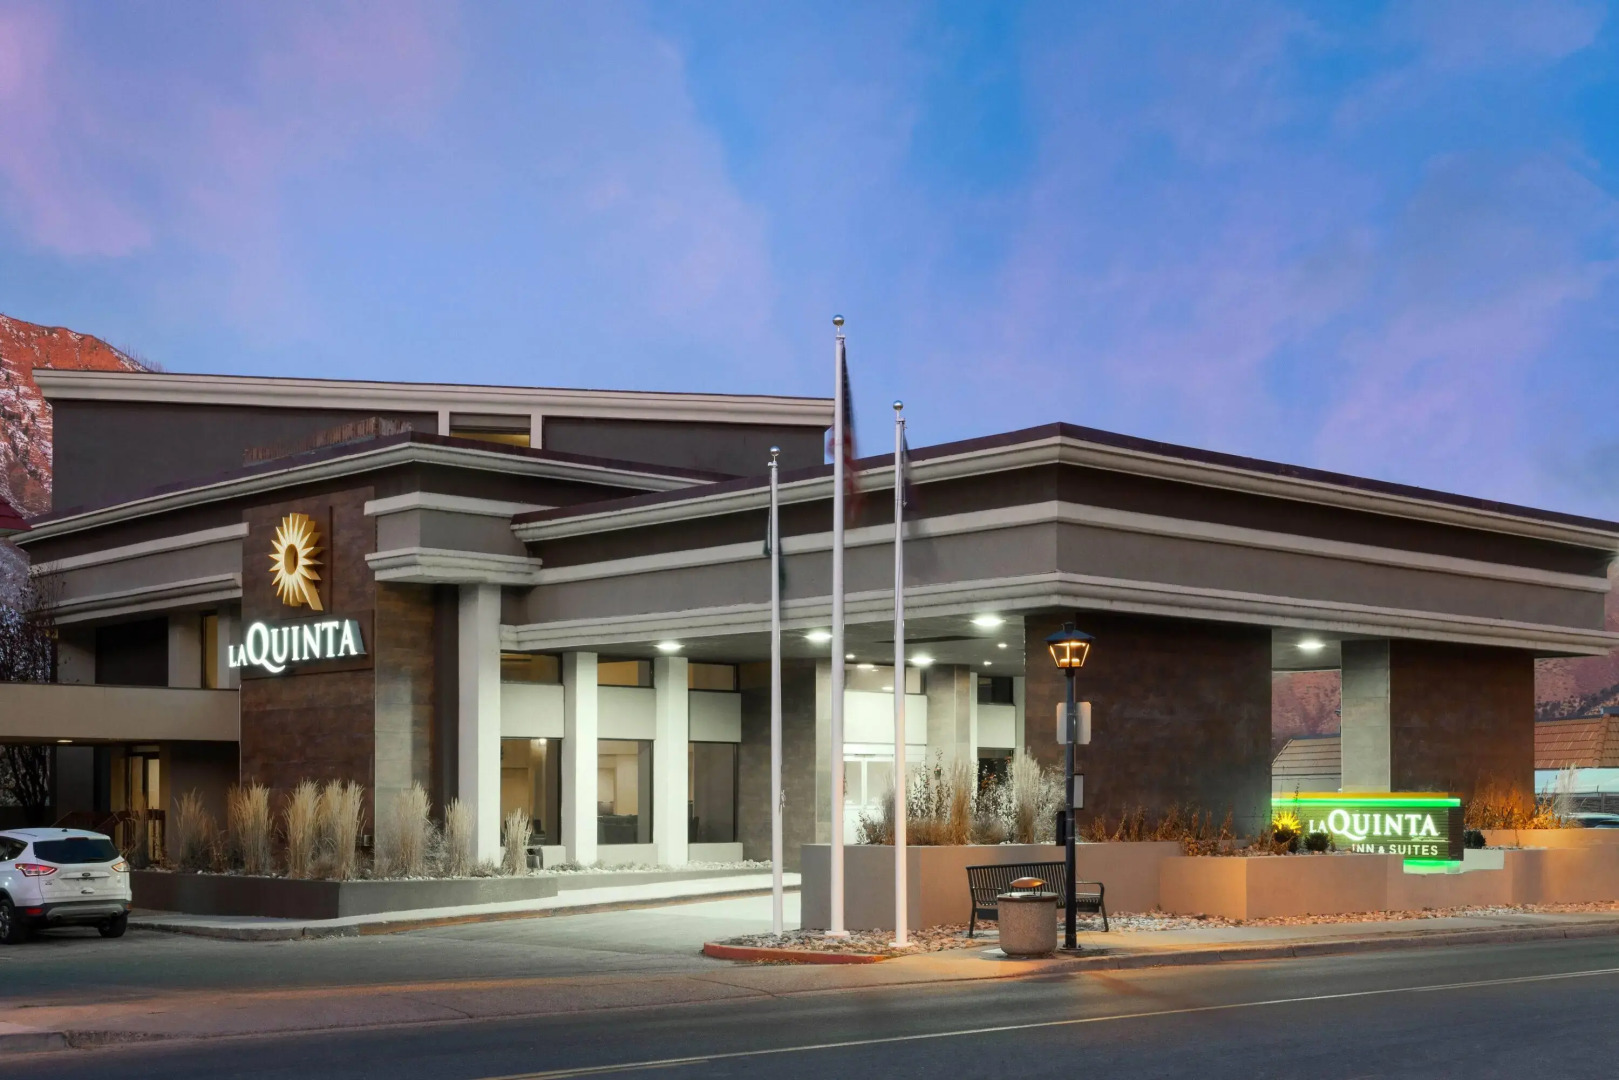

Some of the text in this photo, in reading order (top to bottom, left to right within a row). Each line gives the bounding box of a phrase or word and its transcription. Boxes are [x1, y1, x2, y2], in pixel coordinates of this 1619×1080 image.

[229, 620, 358, 673] LA QUINTA
[1309, 809, 1440, 840] LA QUINTA
[1378, 846, 1385, 854] &
[1389, 844, 1438, 855] SUITES
